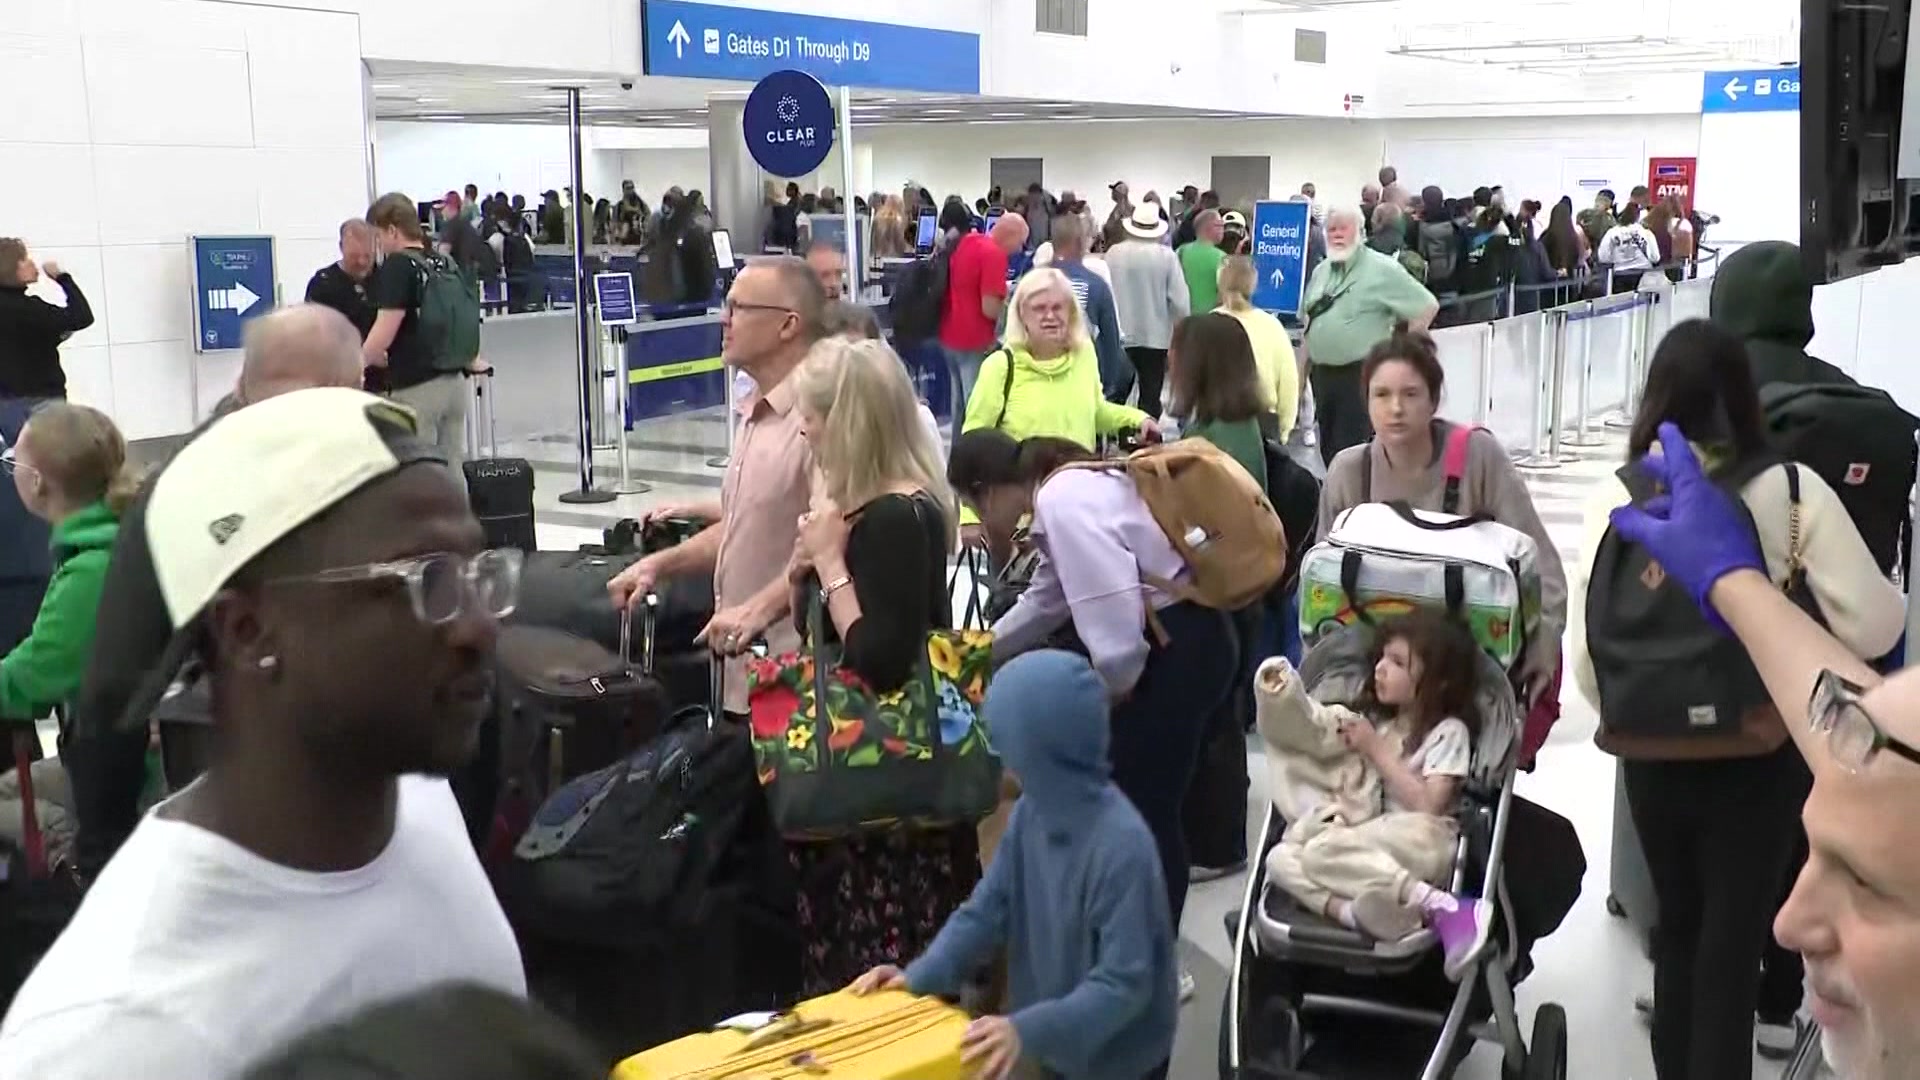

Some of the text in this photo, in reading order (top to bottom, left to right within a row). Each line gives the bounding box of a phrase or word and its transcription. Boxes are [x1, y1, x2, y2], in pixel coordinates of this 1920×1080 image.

[727, 33, 870, 63] Gates D1 Through D9
[1777, 79, 1801, 93] Ga
[766, 127, 814, 143] CLEAR
[1656, 184, 1688, 197] ATM
[1262, 223, 1300, 238] General
[1257, 241, 1301, 259] Boarding
[477, 466, 521, 478] NAUTICA
